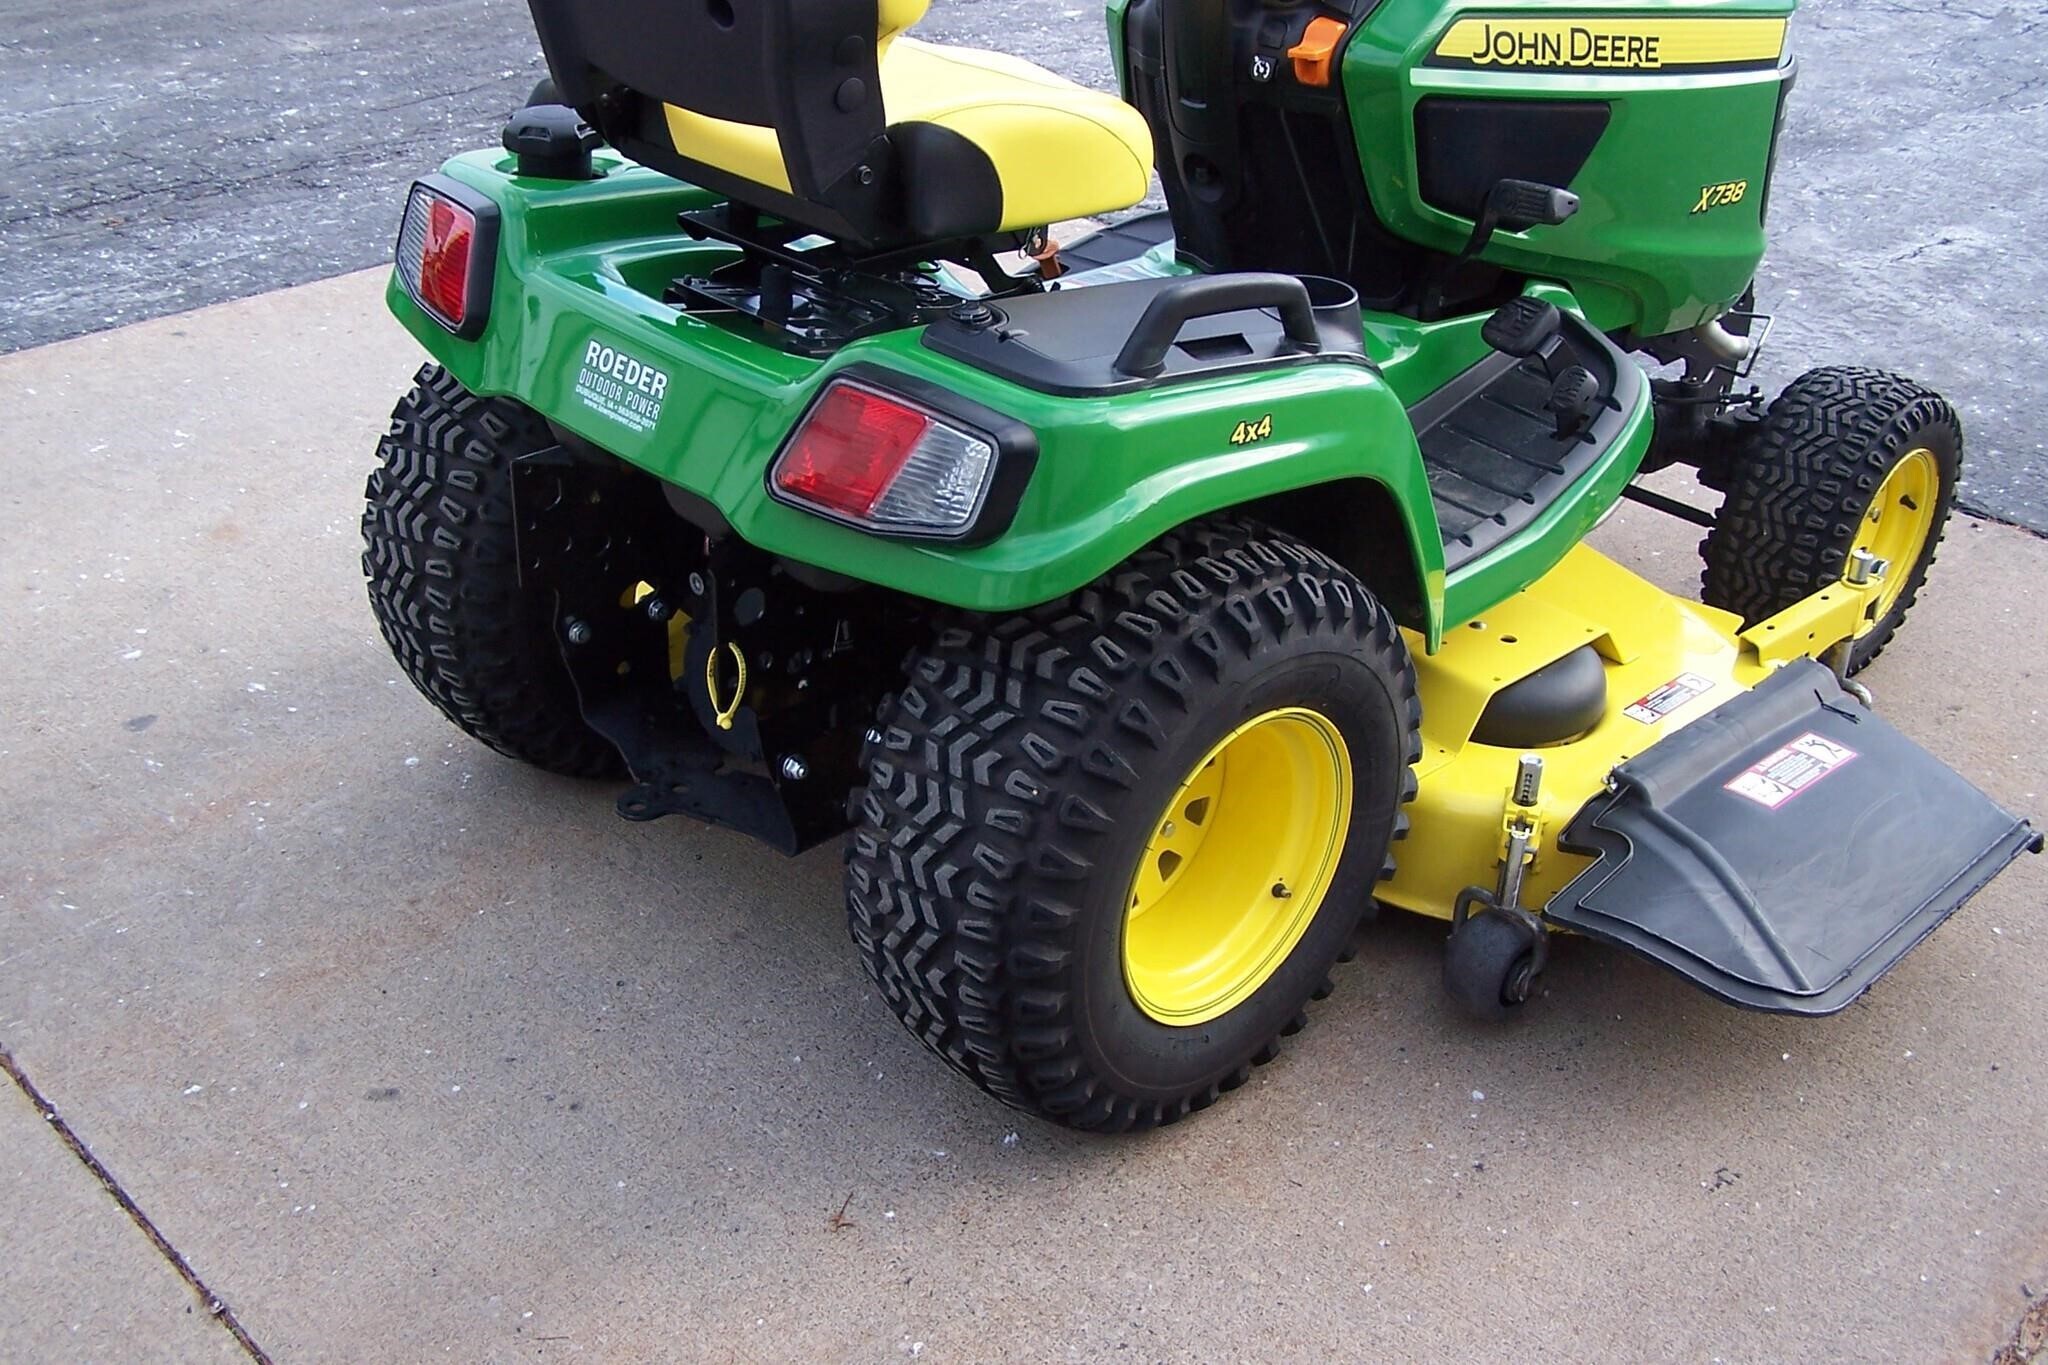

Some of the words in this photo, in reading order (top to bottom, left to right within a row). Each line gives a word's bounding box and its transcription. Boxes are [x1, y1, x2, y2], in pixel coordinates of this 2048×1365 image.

[1472, 23, 1561, 61] JOHN
[1569, 27, 1660, 63] DEERE
[1690, 179, 1748, 215] X738
[584, 340, 668, 400] ROEDER
[579, 368, 623, 402] OUTDOOR
[625, 390, 660, 420] POWER
[1229, 413, 1272, 445] 4x4
